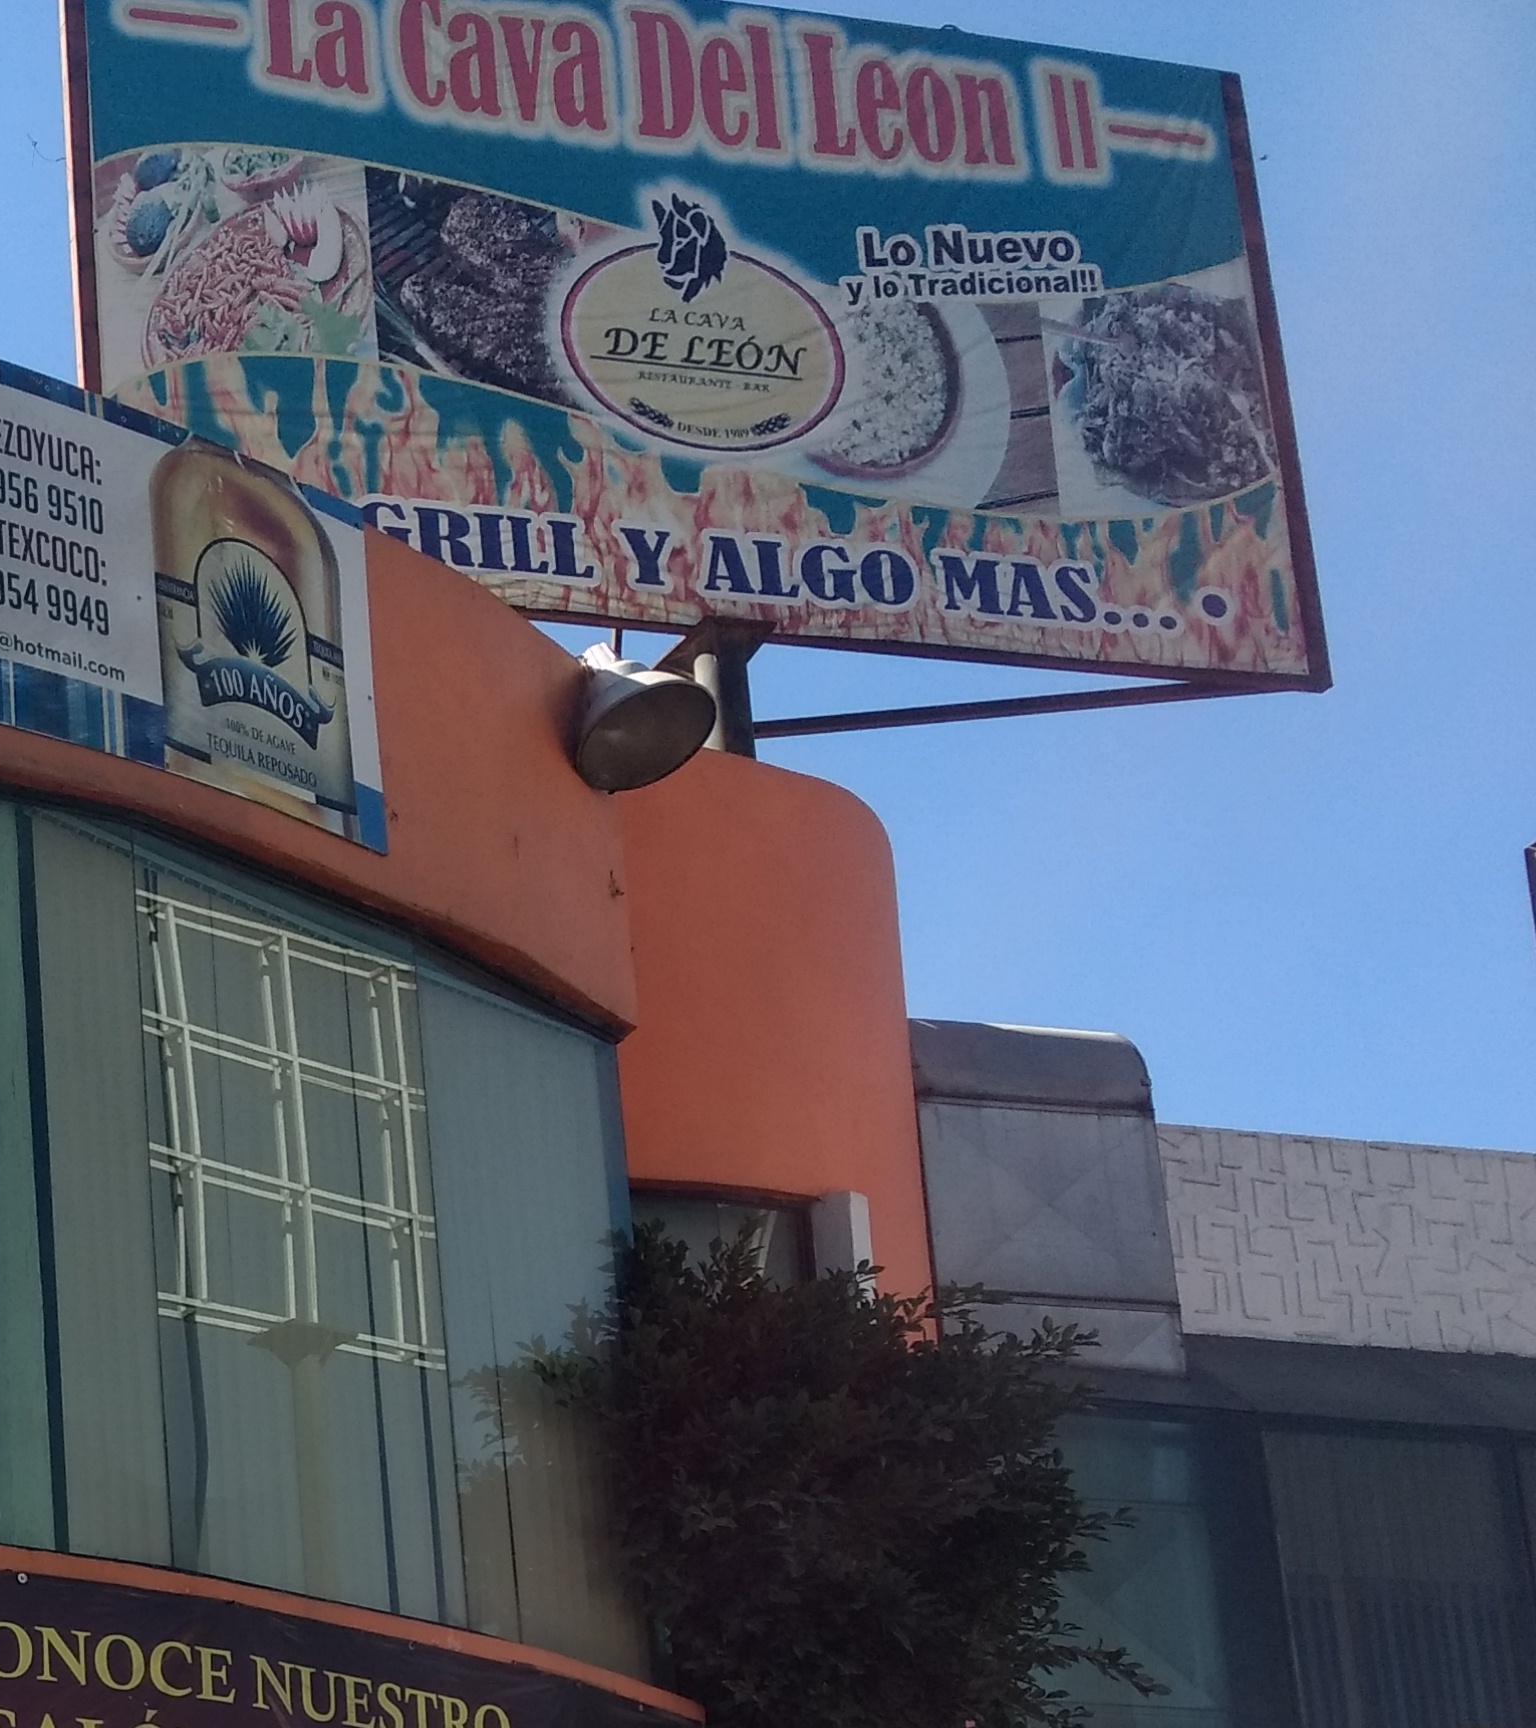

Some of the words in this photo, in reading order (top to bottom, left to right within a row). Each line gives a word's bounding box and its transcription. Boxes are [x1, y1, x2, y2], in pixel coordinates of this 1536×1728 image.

[266, 0, 369, 94] La
[399, 0, 608, 132] Cava
[629, 9, 783, 151] Del
[803, 32, 1016, 167] Leon
[862, 231, 917, 268] Lo
[931, 229, 1075, 266] Nuevo
[845, 279, 864, 306] y
[873, 274, 899, 299] lo
[907, 268, 1098, 297] Tradicional!!
[648, 307, 678, 324] LA
[684, 310, 746, 332] CAVA
[603, 326, 669, 361] DE
[680, 335, 808, 376] LEÓN
[636, 369, 732, 391] RESTAURANTE
[743, 382, 770, 394] BAR
[677, 420, 721, 438] DESDE
[46, 483, 105, 536] 9510
[618, 526, 670, 587] Y
[702, 534, 916, 607] ALGO
[46, 583, 111, 637] 9949
[210, 666, 245, 699] 100
[249, 673, 305, 729] AÑOS
[206, 732, 256, 765] TEQUILA
[257, 752, 318, 789] REPOSADO
[226, 717, 250, 738] 100%
[251, 727, 265, 743] DE
[266, 732, 297, 756] AGAVE
